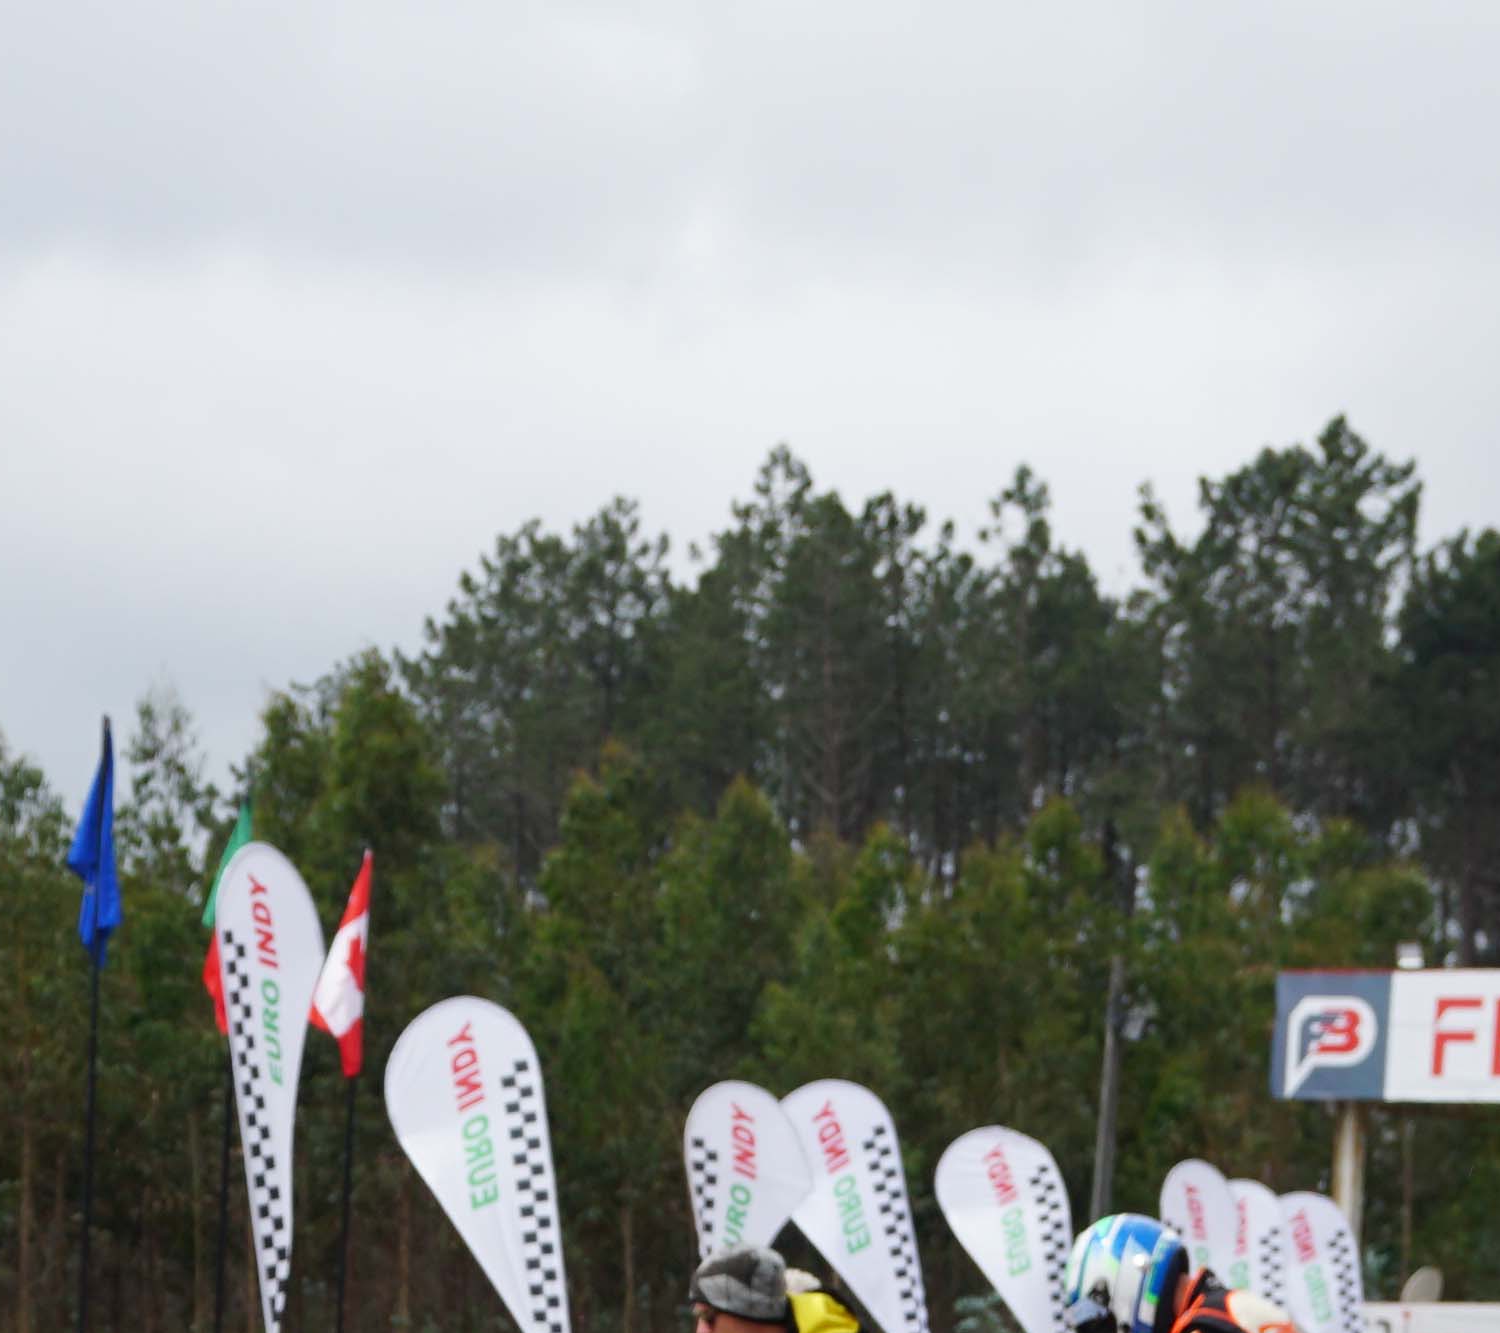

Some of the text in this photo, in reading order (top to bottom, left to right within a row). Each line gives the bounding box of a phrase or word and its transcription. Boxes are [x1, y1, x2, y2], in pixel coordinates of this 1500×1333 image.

[247, 874, 284, 1086] EURO INDY
[722, 1101, 756, 1248] URO INDY
